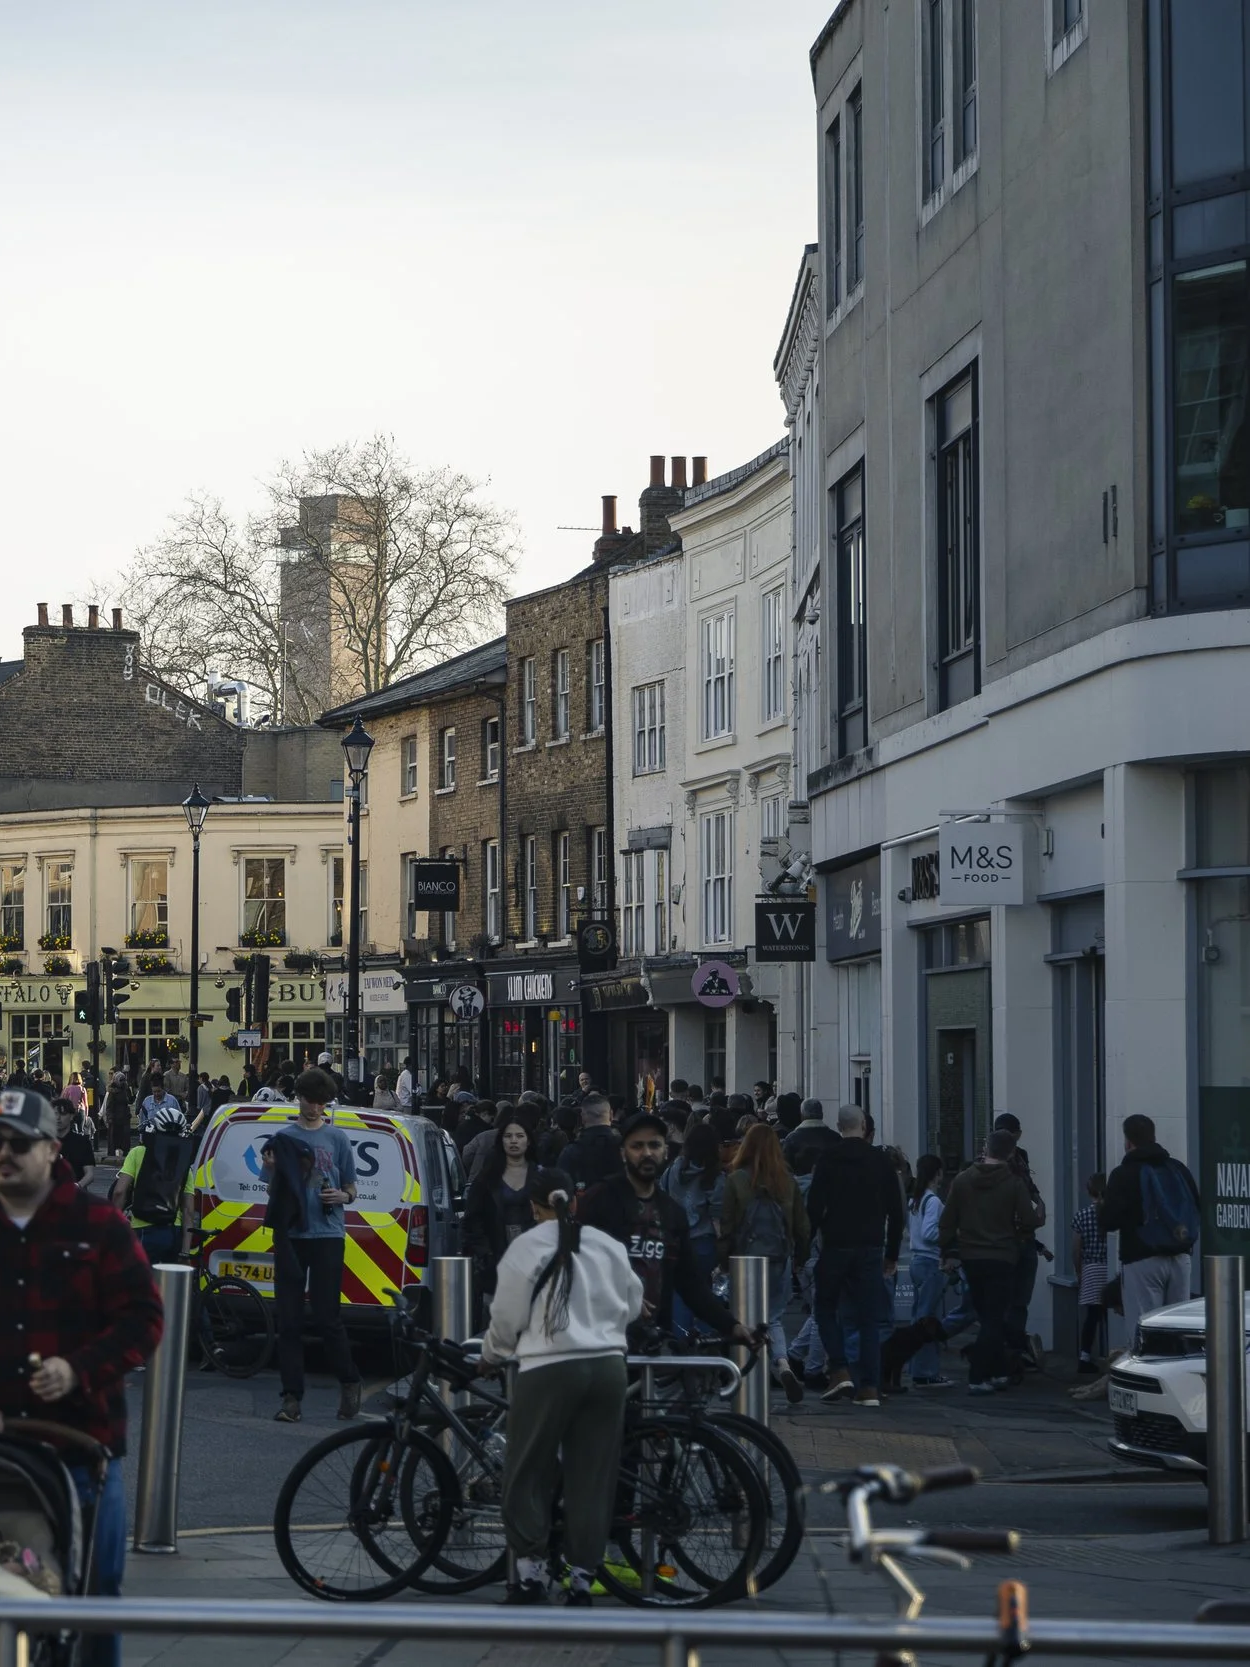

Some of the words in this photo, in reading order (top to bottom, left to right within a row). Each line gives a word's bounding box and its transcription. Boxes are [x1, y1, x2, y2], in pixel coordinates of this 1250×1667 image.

[951, 846, 1013, 869] M&S
[418, 881, 456, 891] BIANCO
[964, 874, 999, 883] FOOD
[765, 913, 806, 940] W
[507, 976, 523, 1001] SLIM
[524, 974, 553, 1000] CHICKENS
[238, 1183, 250, 1191] Tel:
